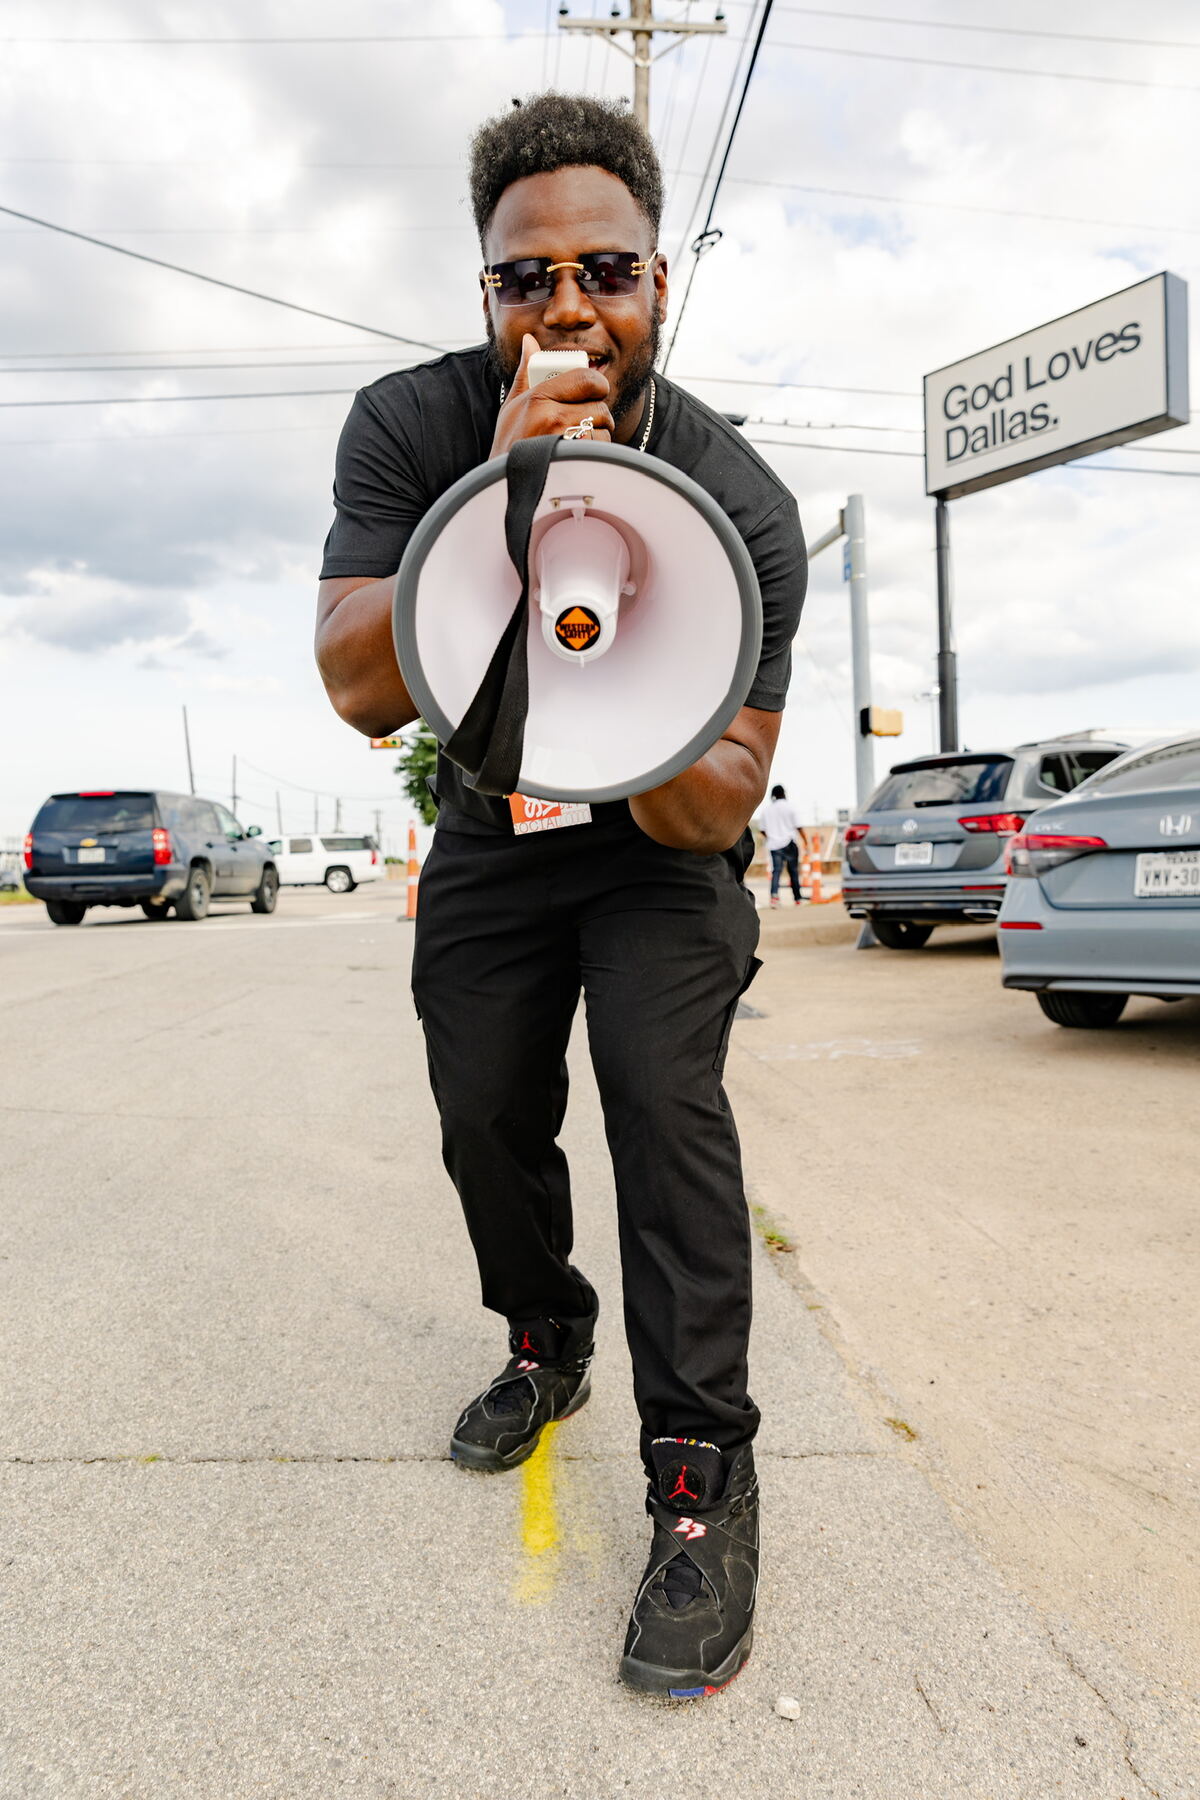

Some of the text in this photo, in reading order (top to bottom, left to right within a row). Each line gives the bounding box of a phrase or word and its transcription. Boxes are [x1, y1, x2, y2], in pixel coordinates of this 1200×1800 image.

[943, 322, 1142, 420] God Loves
[945, 402, 1059, 462] Dallas.
[673, 1516, 707, 1541] 23
